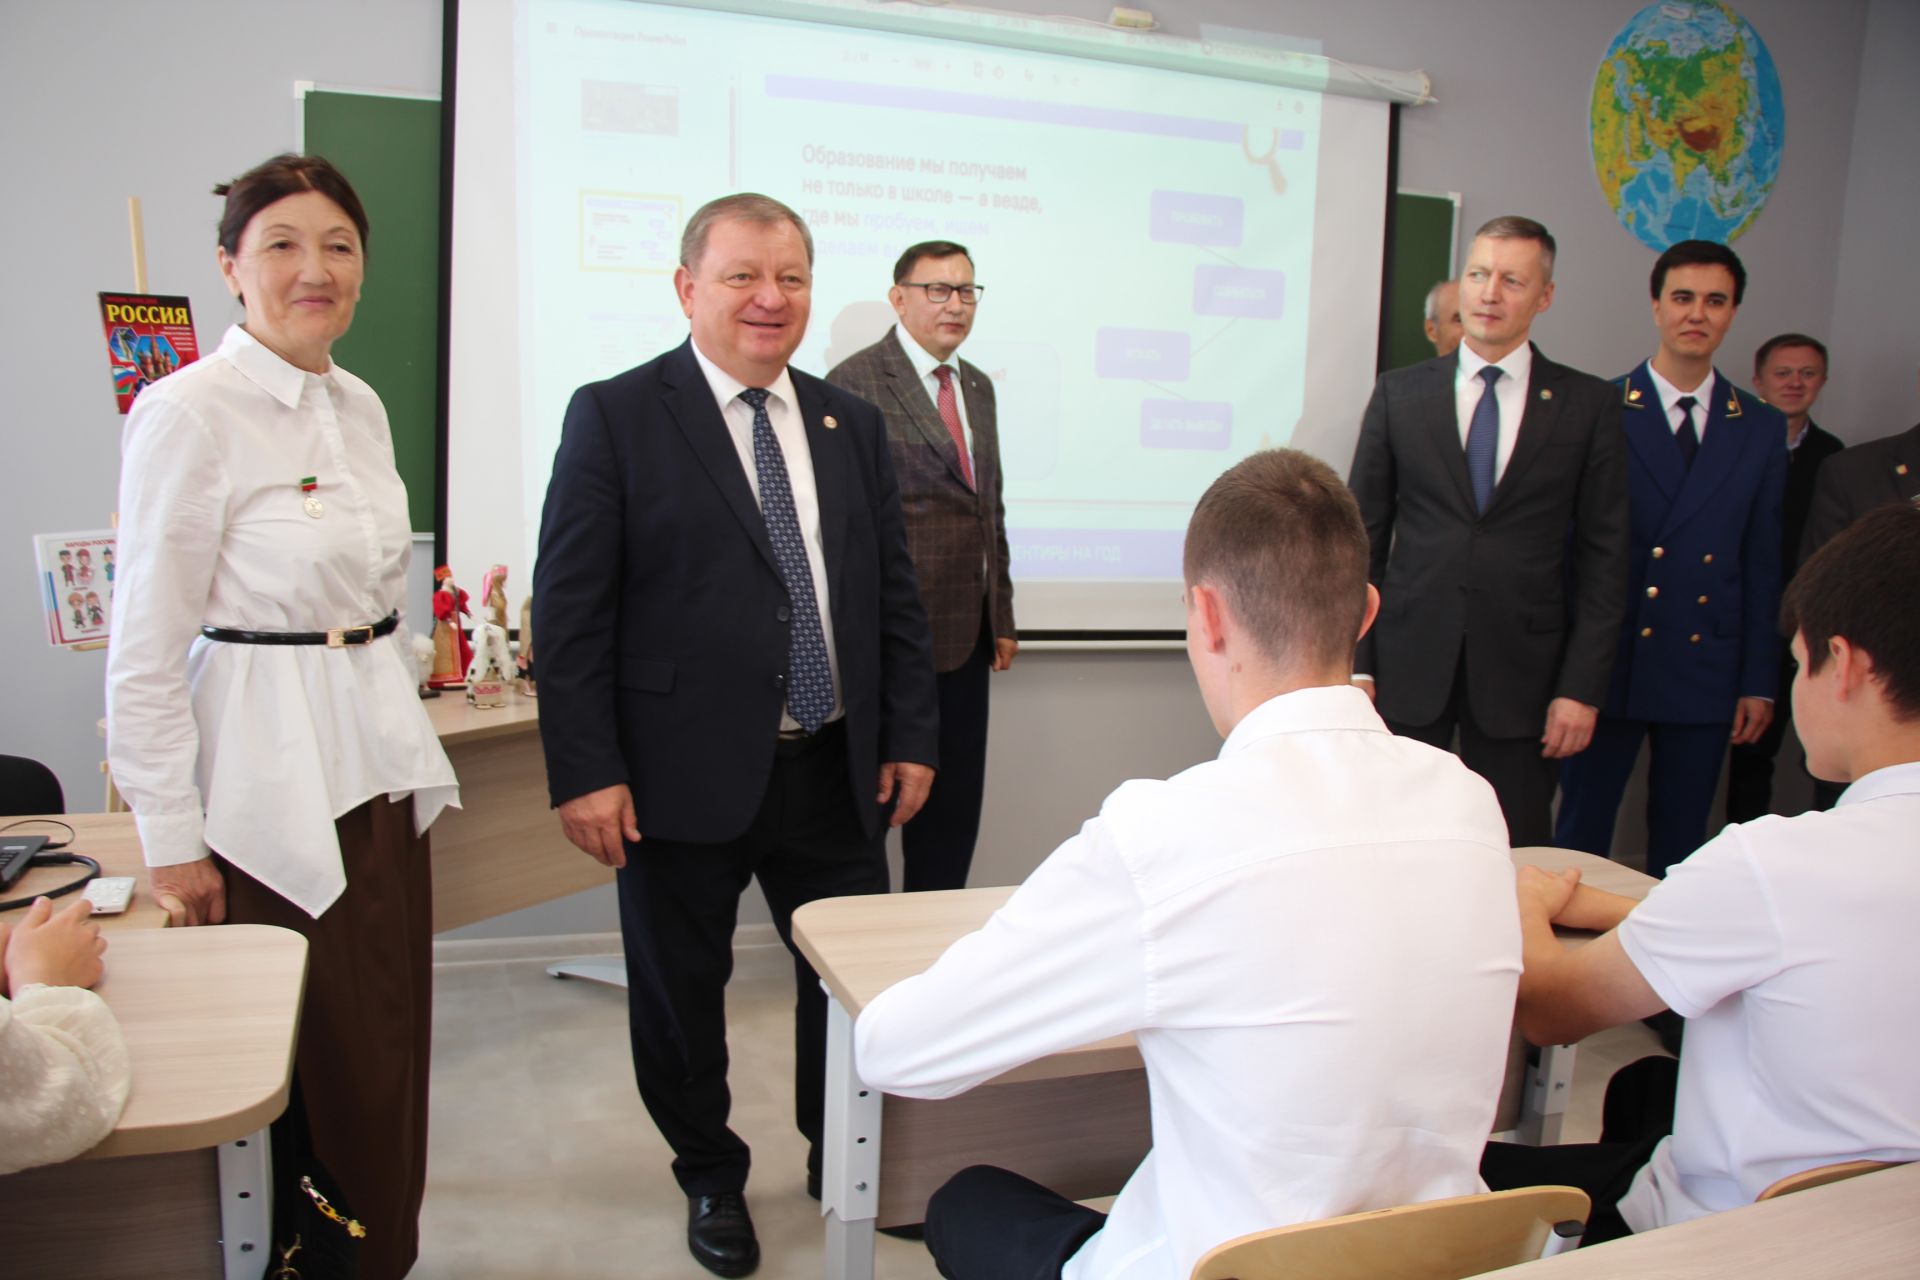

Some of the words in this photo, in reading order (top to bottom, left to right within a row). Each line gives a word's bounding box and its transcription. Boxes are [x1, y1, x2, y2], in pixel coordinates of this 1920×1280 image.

[802, 144, 915, 172] Образование
[919, 157, 944, 175] мы
[949, 160, 1027, 183] получаем
[802, 177, 823, 195] не
[828, 180, 883, 199] только
[888, 184, 897, 200] в
[902, 185, 953, 204] школе
[993, 194, 1042, 214] везде,
[802, 208, 829, 228] где
[834, 211, 858, 228] мы
[106, 304, 190, 324] РОССИЯ
[1011, 544, 1069, 561] ЕНТИРЫ
[1072, 545, 1091, 561] НА
[1095, 545, 1120, 562] ГОД
